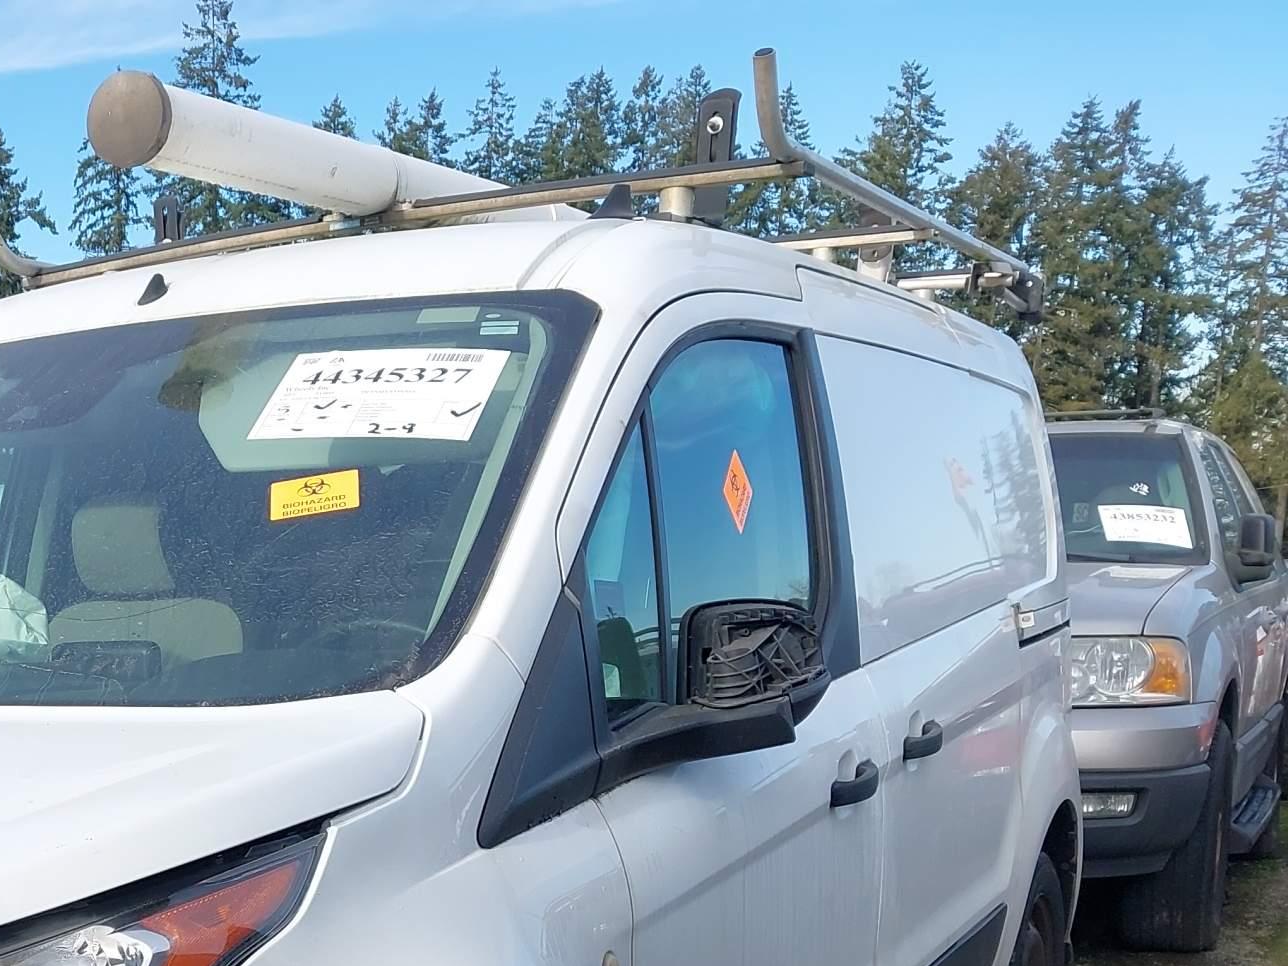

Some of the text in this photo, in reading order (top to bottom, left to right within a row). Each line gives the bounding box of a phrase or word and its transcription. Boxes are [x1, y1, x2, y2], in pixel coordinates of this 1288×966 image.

[302, 367, 473, 385] 44345327
[282, 494, 346, 510] BIOHAZARD
[282, 502, 347, 517] BIOPELIGRO
